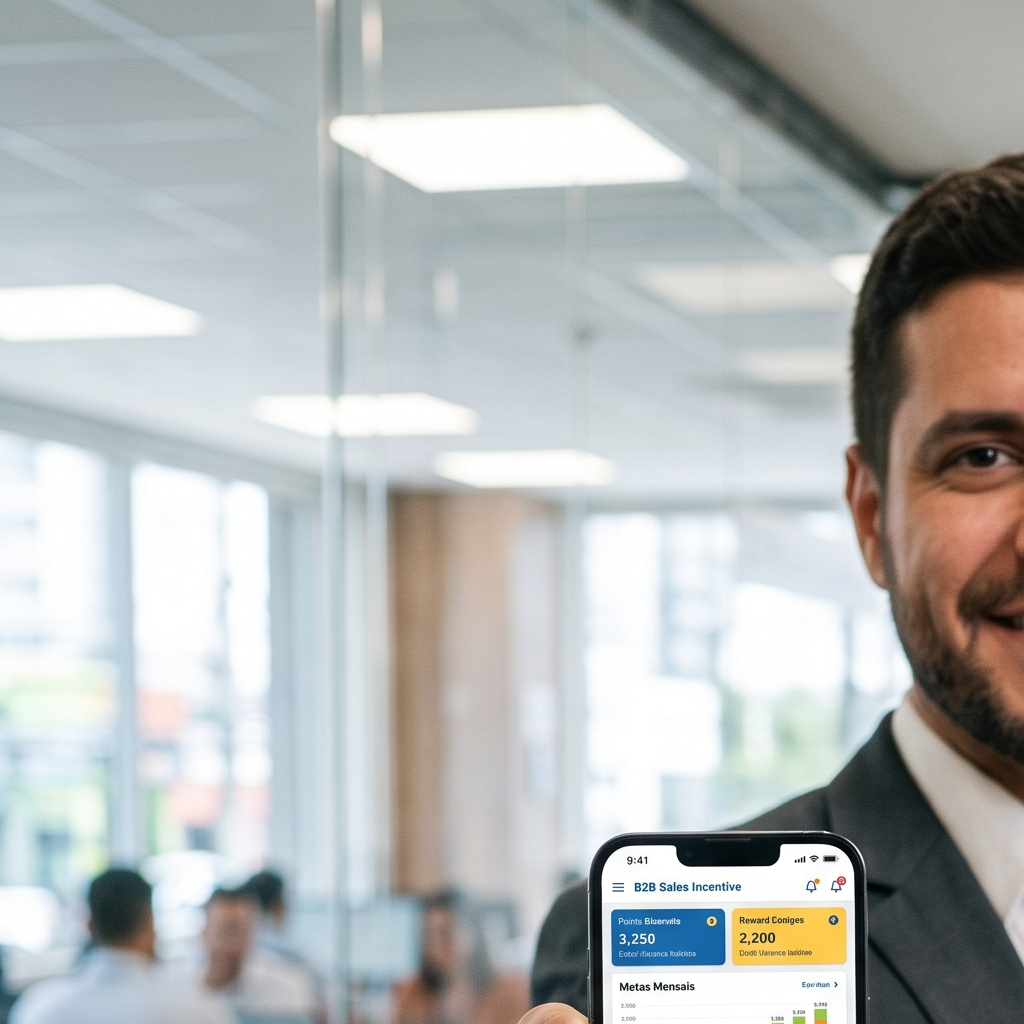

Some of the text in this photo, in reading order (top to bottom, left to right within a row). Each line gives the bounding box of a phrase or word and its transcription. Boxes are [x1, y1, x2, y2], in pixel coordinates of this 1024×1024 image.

[626, 856, 649, 865] 9:41
[634, 881, 742, 892] B2B Sales Incentive
[618, 917, 642, 925] Points
[739, 916, 770, 924] Reward
[619, 933, 656, 946] 3,250
[739, 932, 776, 945] 2,200
[619, 981, 696, 992] Metas Mensais
